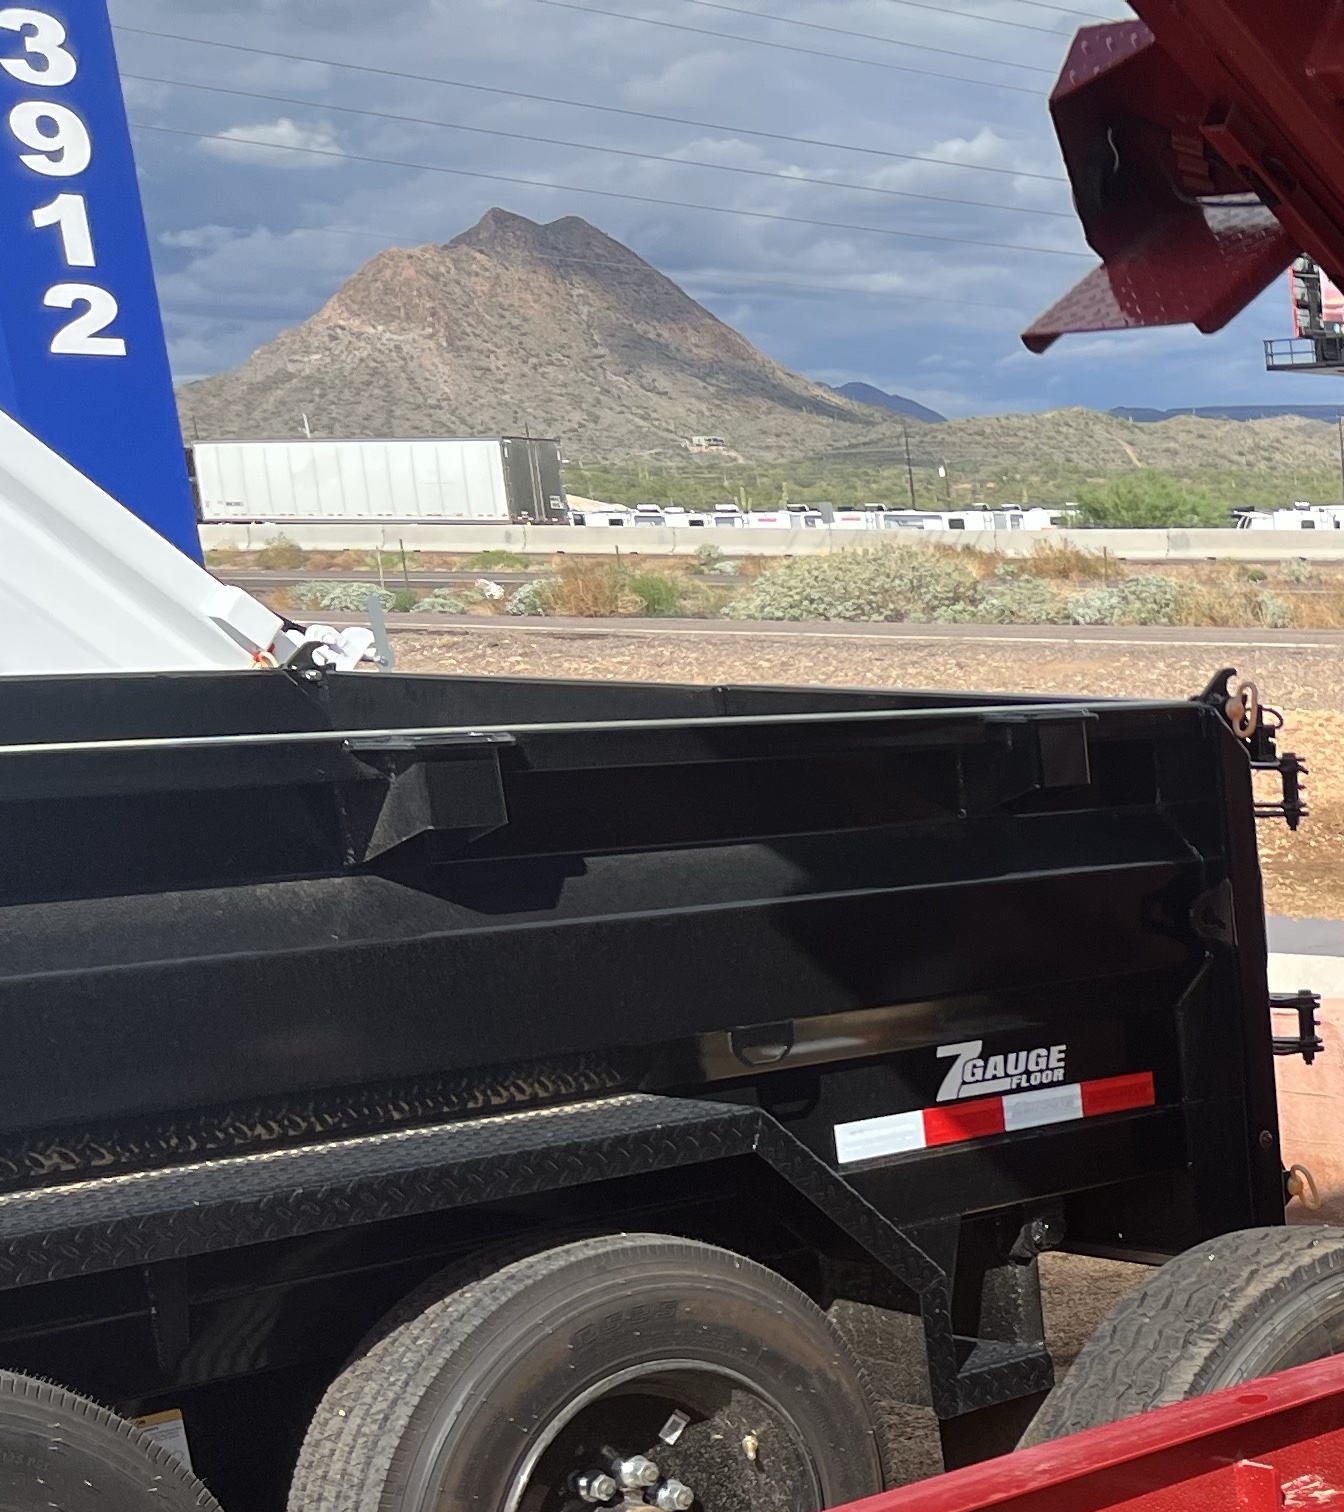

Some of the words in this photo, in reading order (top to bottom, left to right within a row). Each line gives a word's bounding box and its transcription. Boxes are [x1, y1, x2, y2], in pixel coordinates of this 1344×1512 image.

[936, 1040, 982, 1101] 7
[963, 1045, 1066, 1082] GAUGE
[1009, 1068, 1064, 1090] FLOOR
